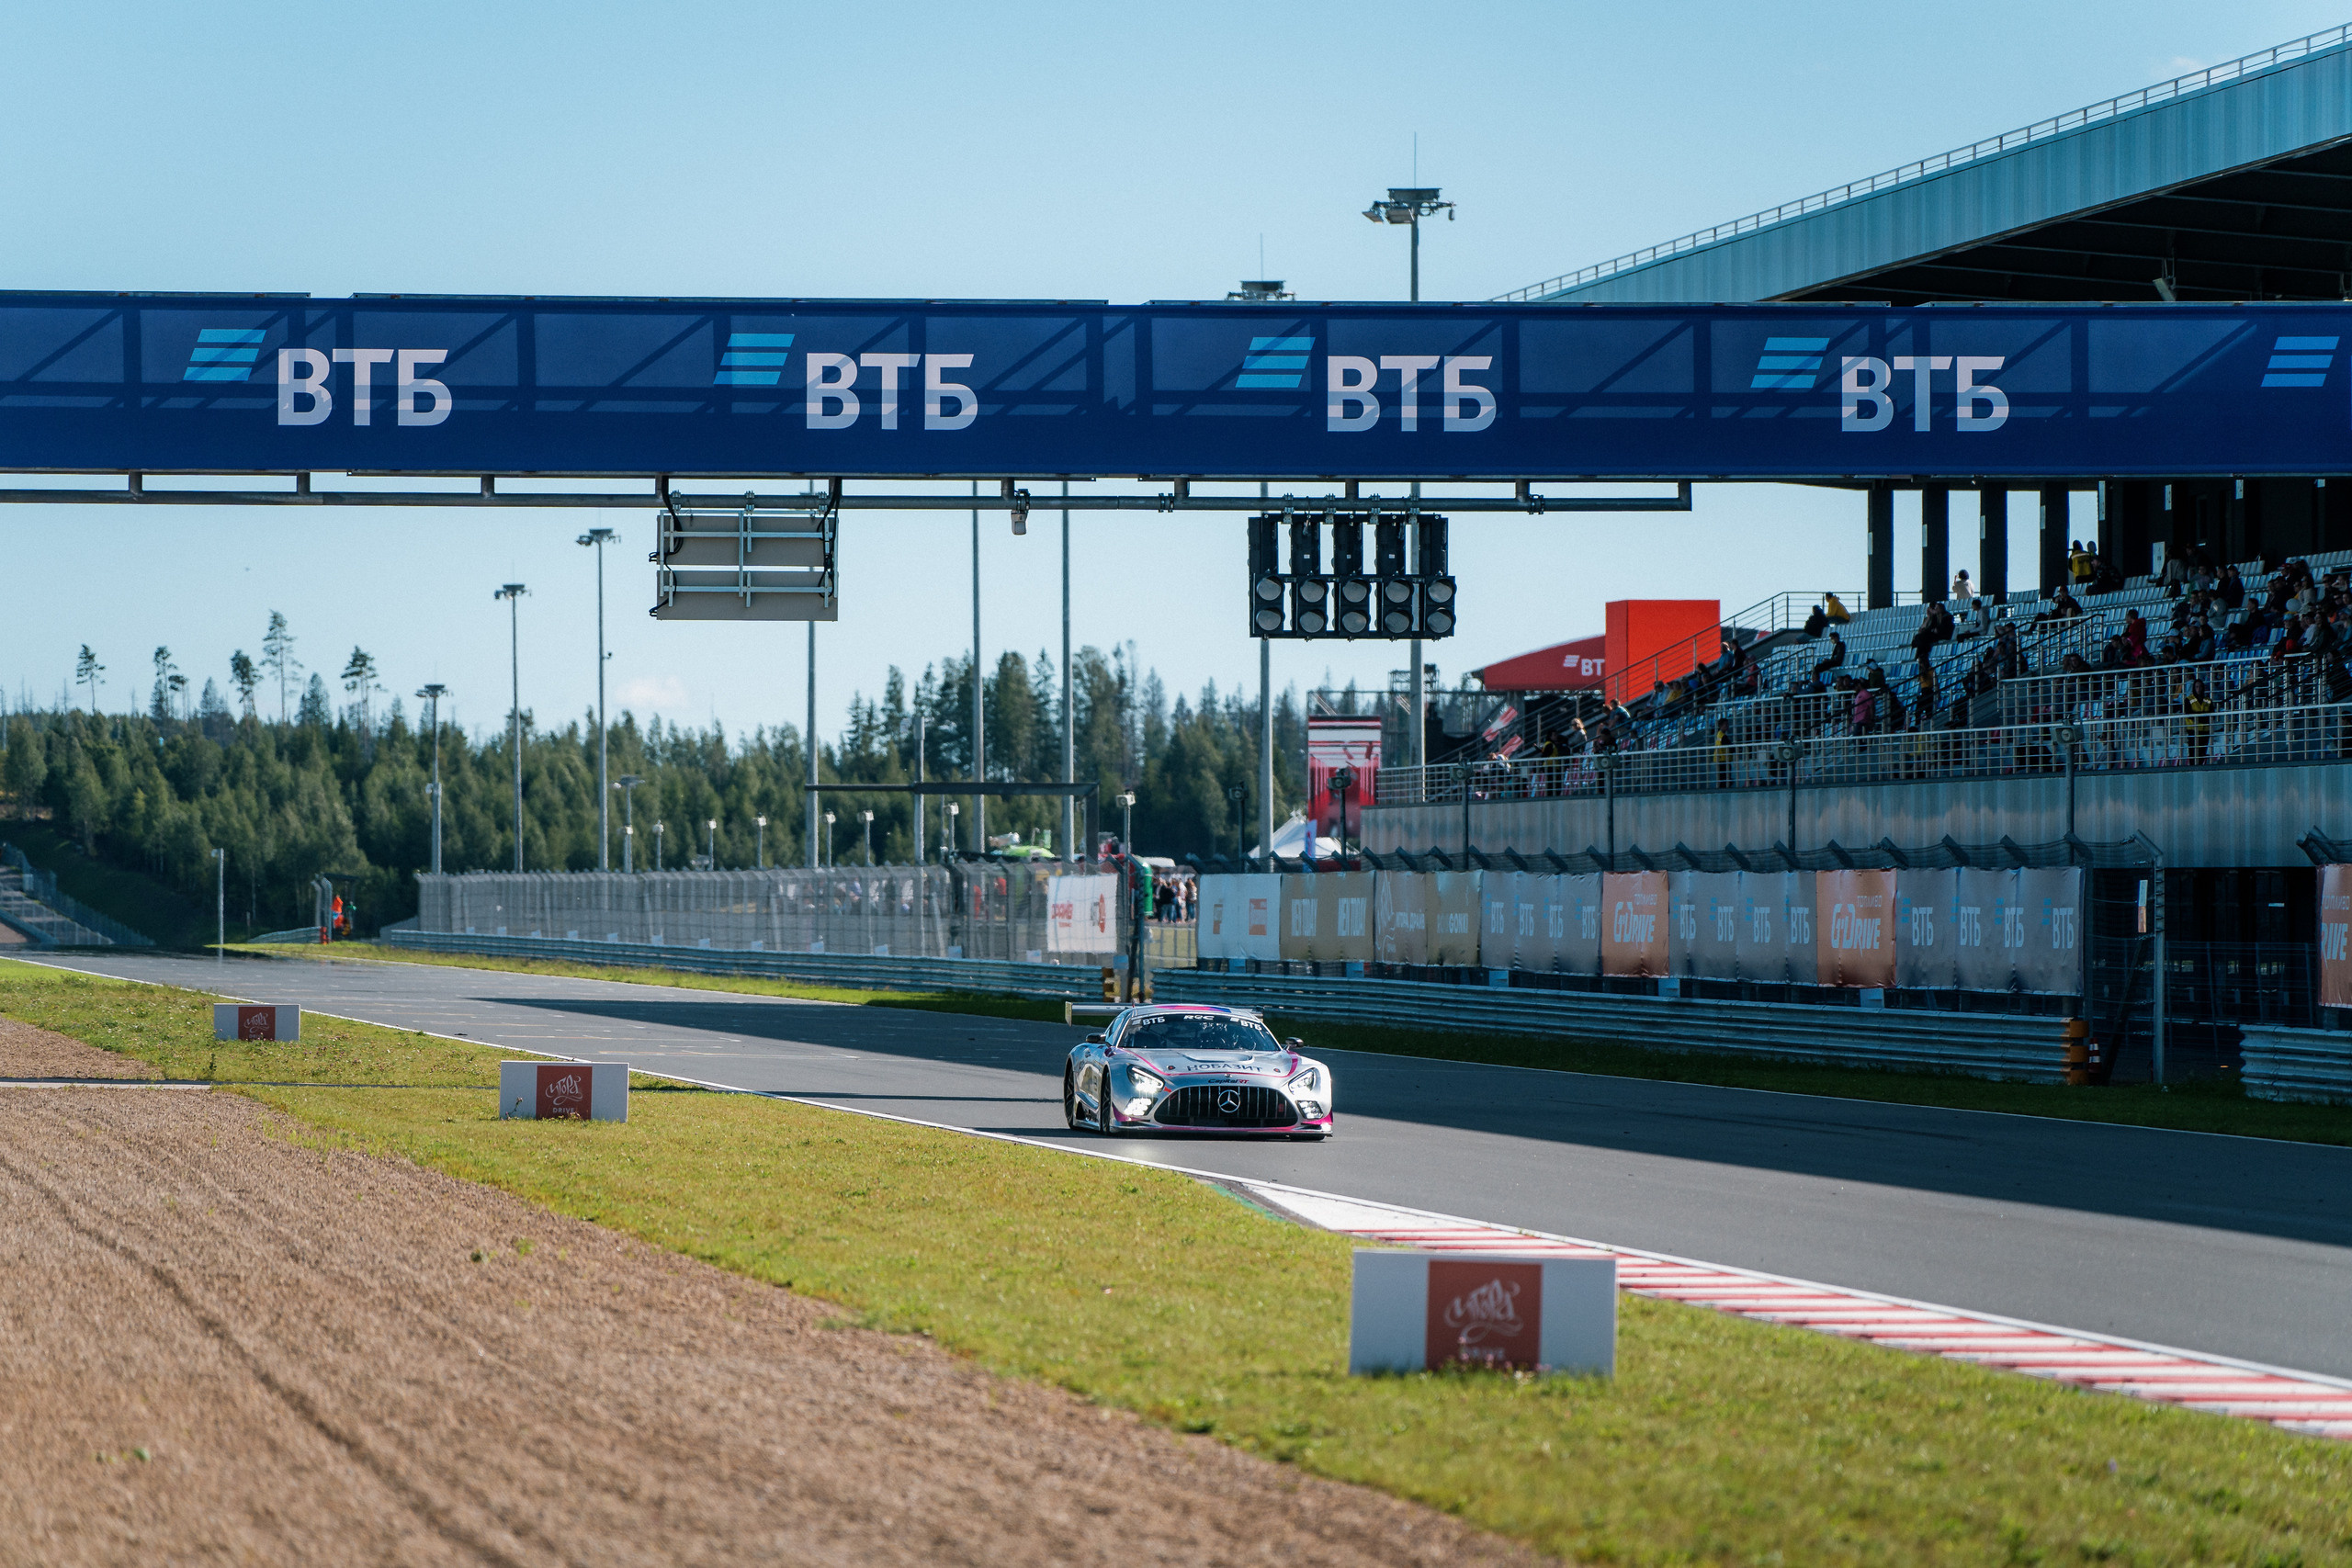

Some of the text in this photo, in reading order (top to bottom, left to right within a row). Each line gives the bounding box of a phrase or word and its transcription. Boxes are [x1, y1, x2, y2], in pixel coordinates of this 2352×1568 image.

[277, 348, 452, 426] ВТБ
[806, 353, 978, 431] ВТБ
[1327, 355, 1497, 432] ВТБ
[1841, 356, 2009, 432] ВТБ
[1581, 659, 1605, 676] ВТ
[1491, 901, 1505, 934] ВТБ
[1519, 903, 1534, 936] ВТБ
[1549, 905, 1564, 939] ВТБ
[1582, 906, 1596, 940] ВТБ
[1679, 905, 1696, 940] ВТБ
[1717, 906, 1734, 942] ВТБ
[1753, 907, 1770, 943] ВТБ
[1791, 907, 1810, 944] ВТБ
[1912, 907, 1934, 946] ВТБ
[1960, 906, 1981, 947] ВТБ
[2004, 907, 2025, 948] ВТБ
[2052, 908, 2075, 949] ВТБ
[1142, 1016, 1166, 1026] ВТБ
[1240, 1020, 1262, 1032] ВТБ
[1186, 1063, 1263, 1073] НОБАЗИТ
